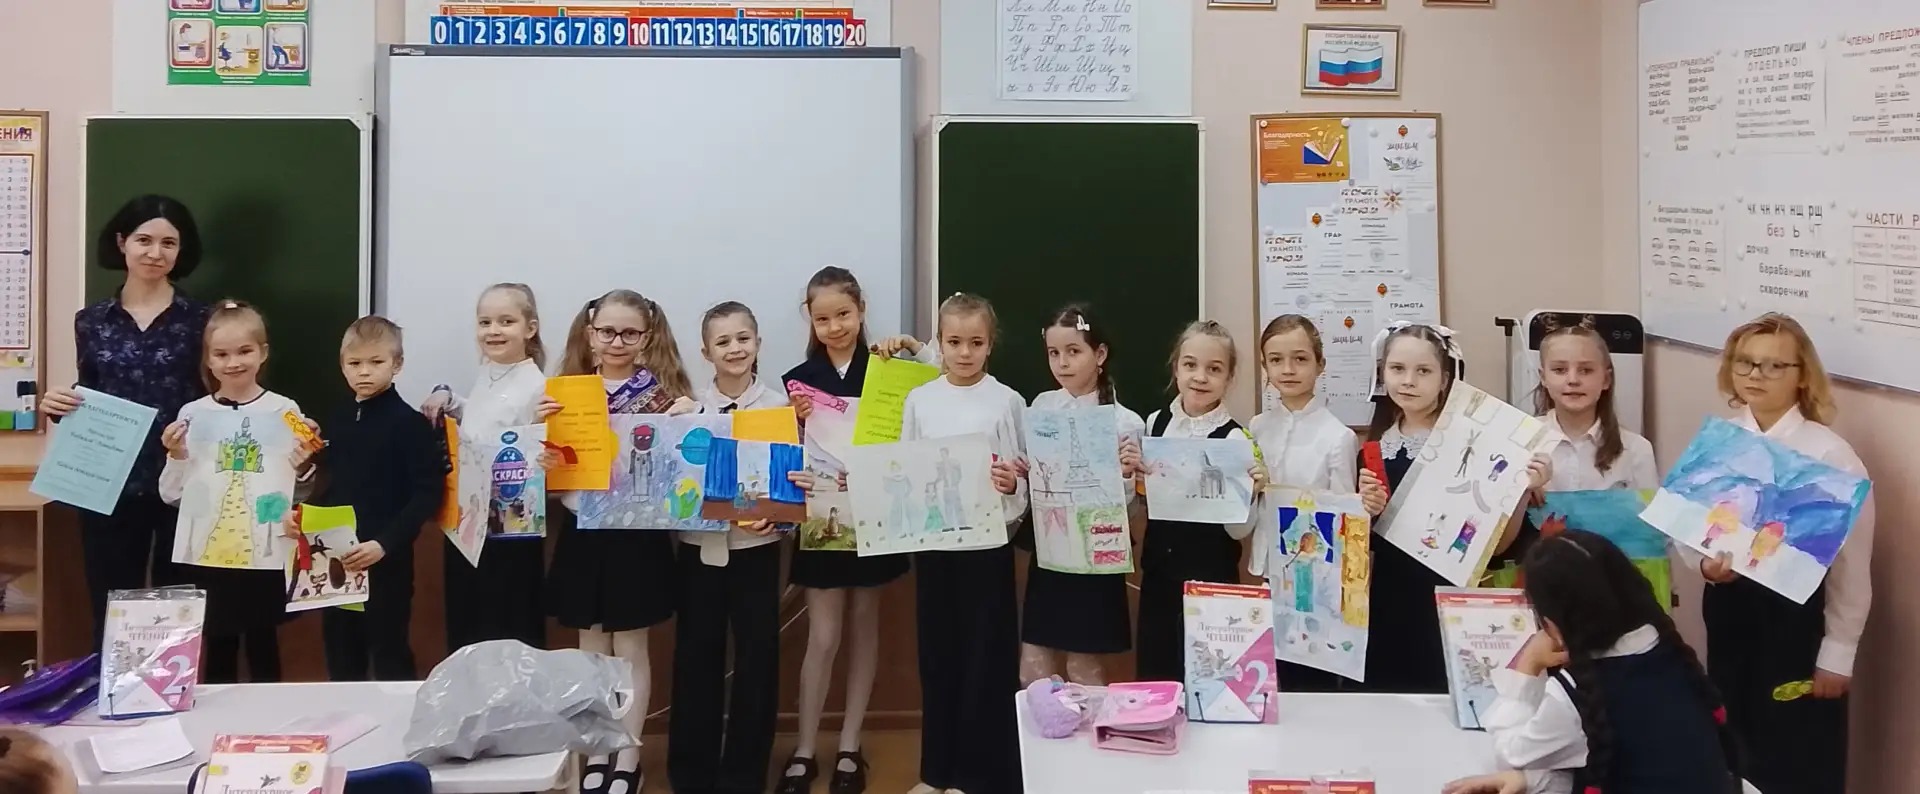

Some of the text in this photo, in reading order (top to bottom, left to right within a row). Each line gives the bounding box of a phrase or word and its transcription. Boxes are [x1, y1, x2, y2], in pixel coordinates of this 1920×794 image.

[434, 21, 865, 46] 0 1 2 3 4 5 6 7 8 9 10 11 12 13 14 15 16 17 18 19 20
[1744, 42, 1807, 58] ПРЕДЛОГИ ПИШИ
[1808, 204, 1823, 219] рщ
[1866, 213, 1904, 225] ЧАСТИ
[1767, 222, 1785, 237] без
[1746, 245, 1827, 259] дочка птенчик
[1760, 263, 1811, 278] барабанщик
[1760, 285, 1809, 298] скворечник
[160, 654, 195, 695] 2
[1245, 660, 1269, 703] 2
